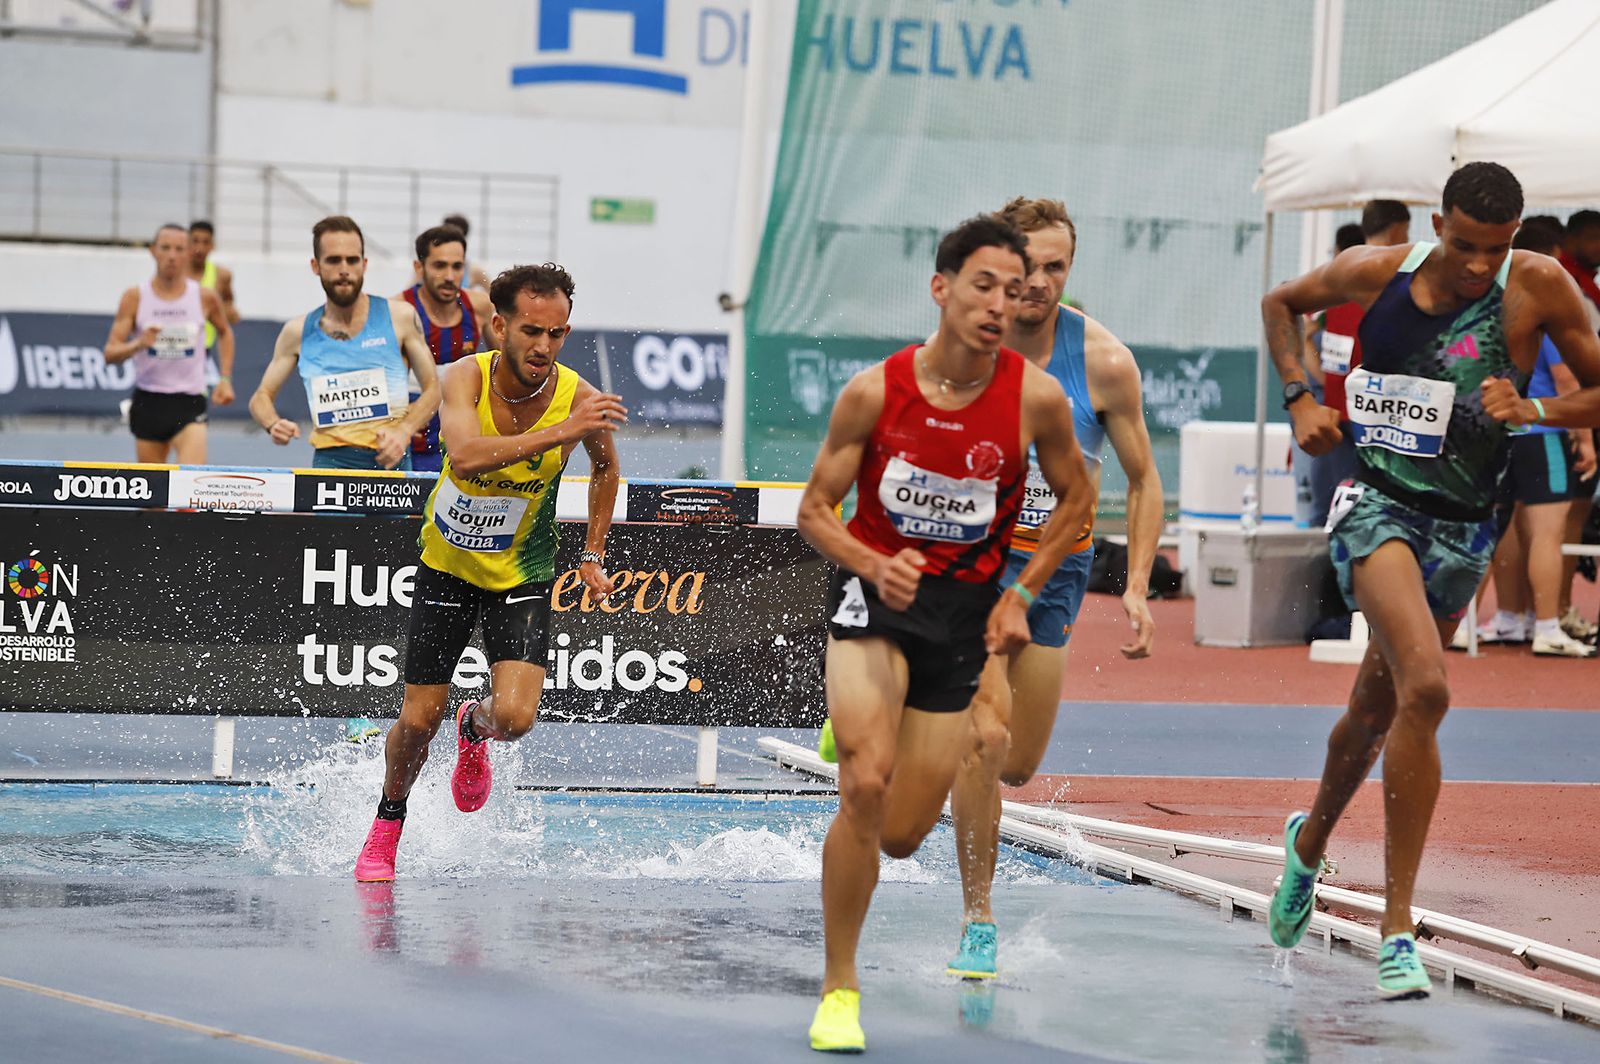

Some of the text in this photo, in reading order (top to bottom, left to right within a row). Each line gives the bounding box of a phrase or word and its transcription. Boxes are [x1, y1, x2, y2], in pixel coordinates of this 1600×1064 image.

[700, 8, 748, 66] D
[804, 13, 1033, 80] HUELVA
[319, 386, 380, 404] MARTOS
[331, 406, 375, 423] Joma
[1354, 394, 1439, 423] BARROS
[1361, 427, 1419, 450] Joma
[53, 474, 153, 501] Joma
[193, 489, 229, 497] Continental
[348, 482, 421, 496] DIPUTACIÓN
[1024, 487, 1057, 498] RSH
[348, 496, 413, 508] DE HUELVA
[661, 503, 696, 511] Continental
[896, 487, 976, 513] OUGRA
[448, 506, 506, 528] BOUIH
[898, 516, 964, 538] Joma
[1018, 509, 1050, 525] ma
[444, 527, 495, 549] Joma
[468, 526, 484, 535] 75
[302, 548, 706, 615] Hue eeva
[0, 635, 76, 648] DESARROLLO
[0, 647, 76, 662] STENIBLE
[297, 633, 703, 693] tus eidos.
